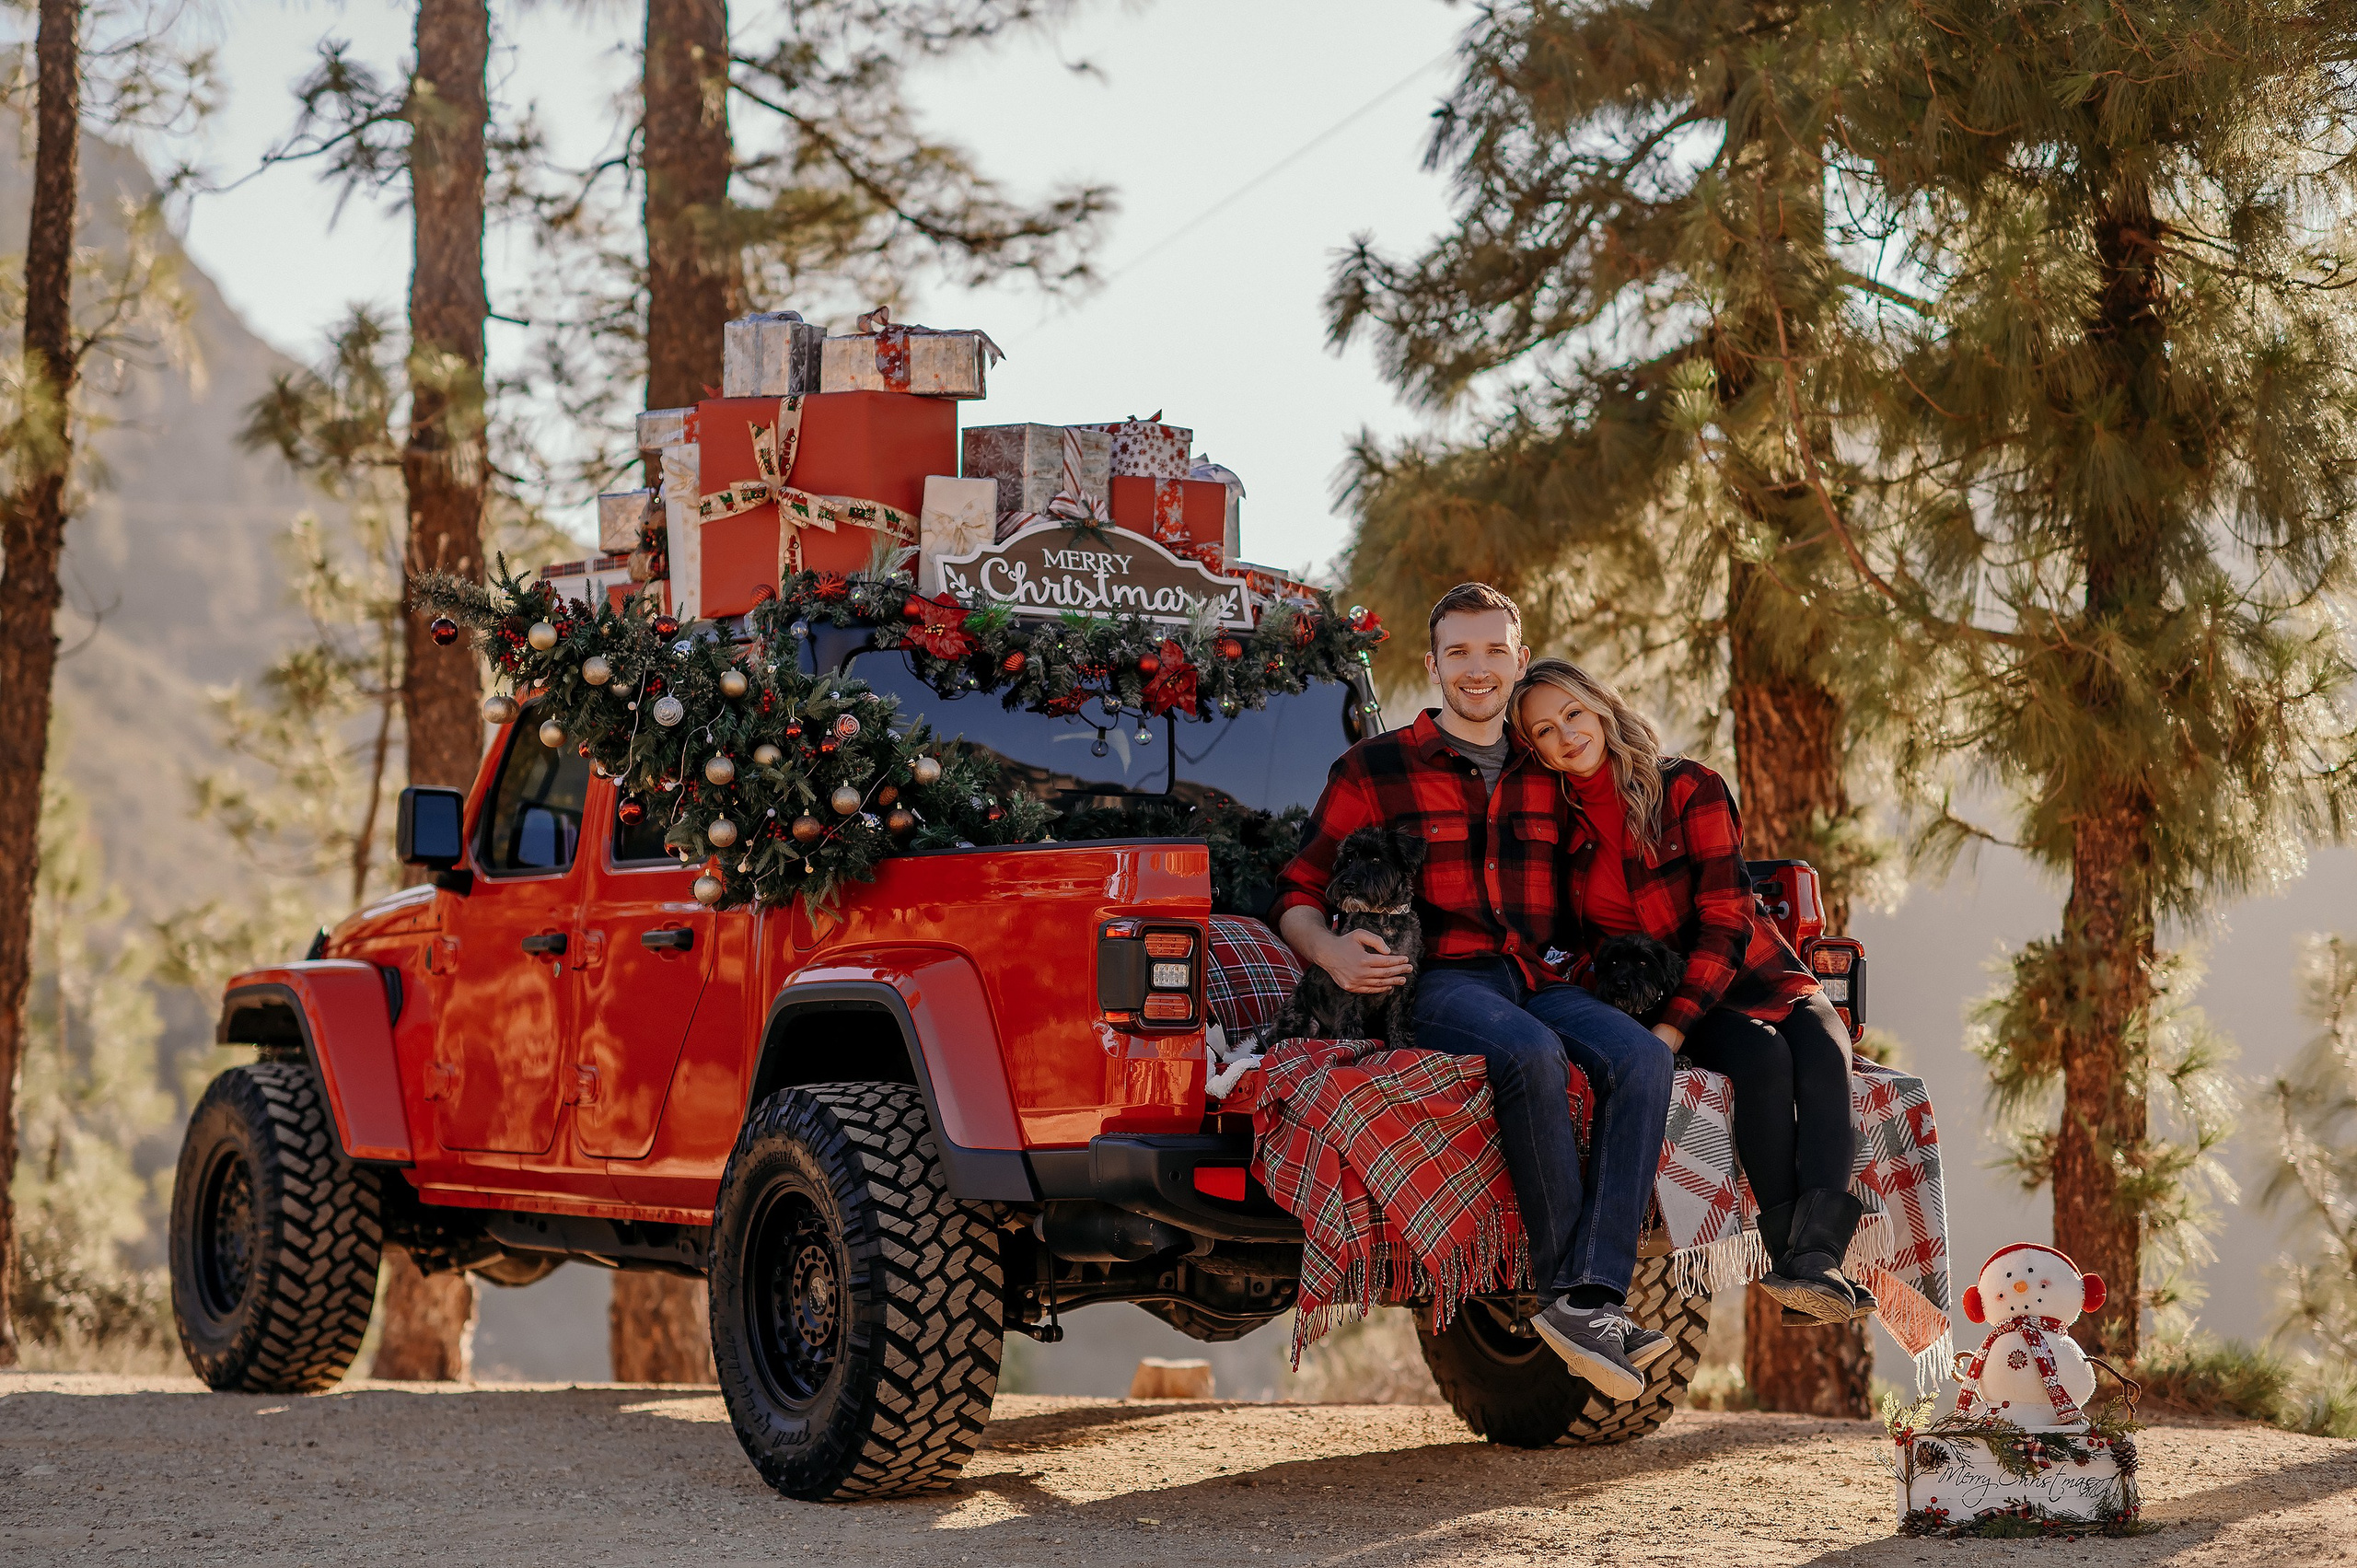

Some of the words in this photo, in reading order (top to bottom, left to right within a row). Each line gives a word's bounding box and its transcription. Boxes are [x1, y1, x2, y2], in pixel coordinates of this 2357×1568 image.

[1042, 548, 1132, 575] MERRY
[980, 557, 1208, 615] Christmas
[1937, 1462, 1999, 1508] Merry
